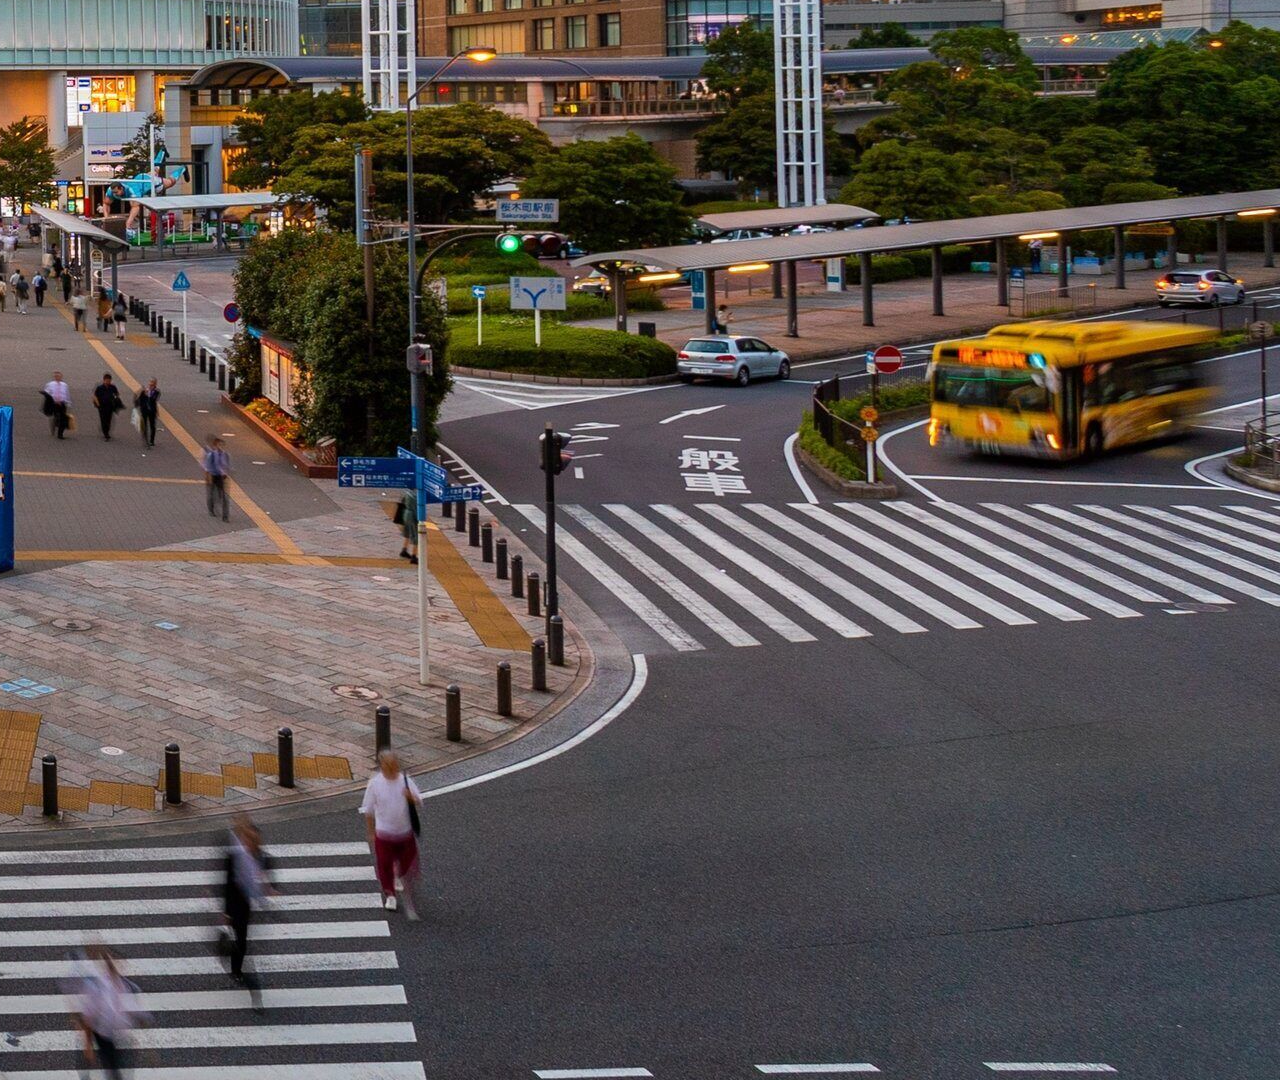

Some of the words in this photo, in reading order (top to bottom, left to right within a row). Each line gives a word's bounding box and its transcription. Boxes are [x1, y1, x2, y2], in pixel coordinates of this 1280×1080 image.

[501, 202, 555, 213] 桜木町駅前
